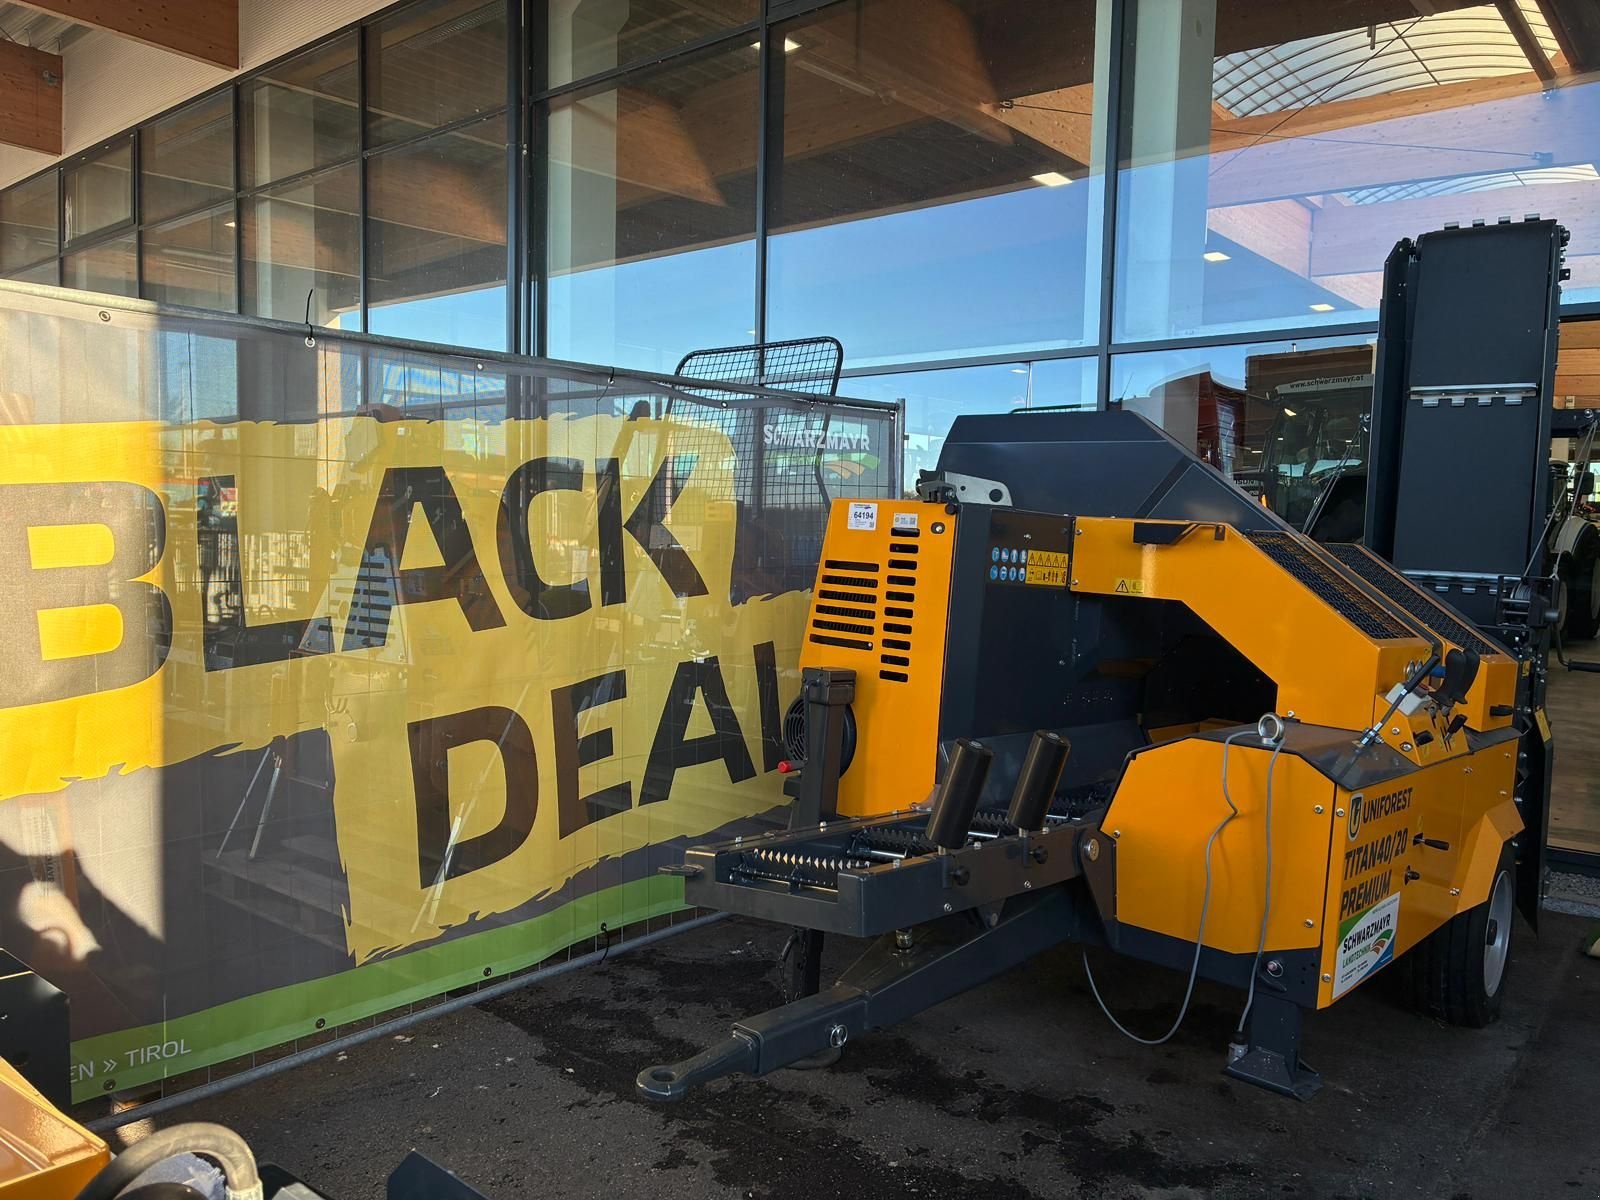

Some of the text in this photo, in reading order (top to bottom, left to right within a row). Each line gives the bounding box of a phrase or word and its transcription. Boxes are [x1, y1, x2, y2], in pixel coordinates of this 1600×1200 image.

[1290, 374, 1364, 389] www.schwarzmayr.at
[763, 424, 870, 451] SCHWARZMAYR
[853, 511, 874, 520] 64194
[0, 454, 709, 710] BLACK
[1363, 787, 1413, 824] UNIFOREST
[1340, 869, 1392, 920] PREMIUM
[1343, 914, 1391, 954] SCHWARZMAYR
[125, 1039, 192, 1067] TIROL
